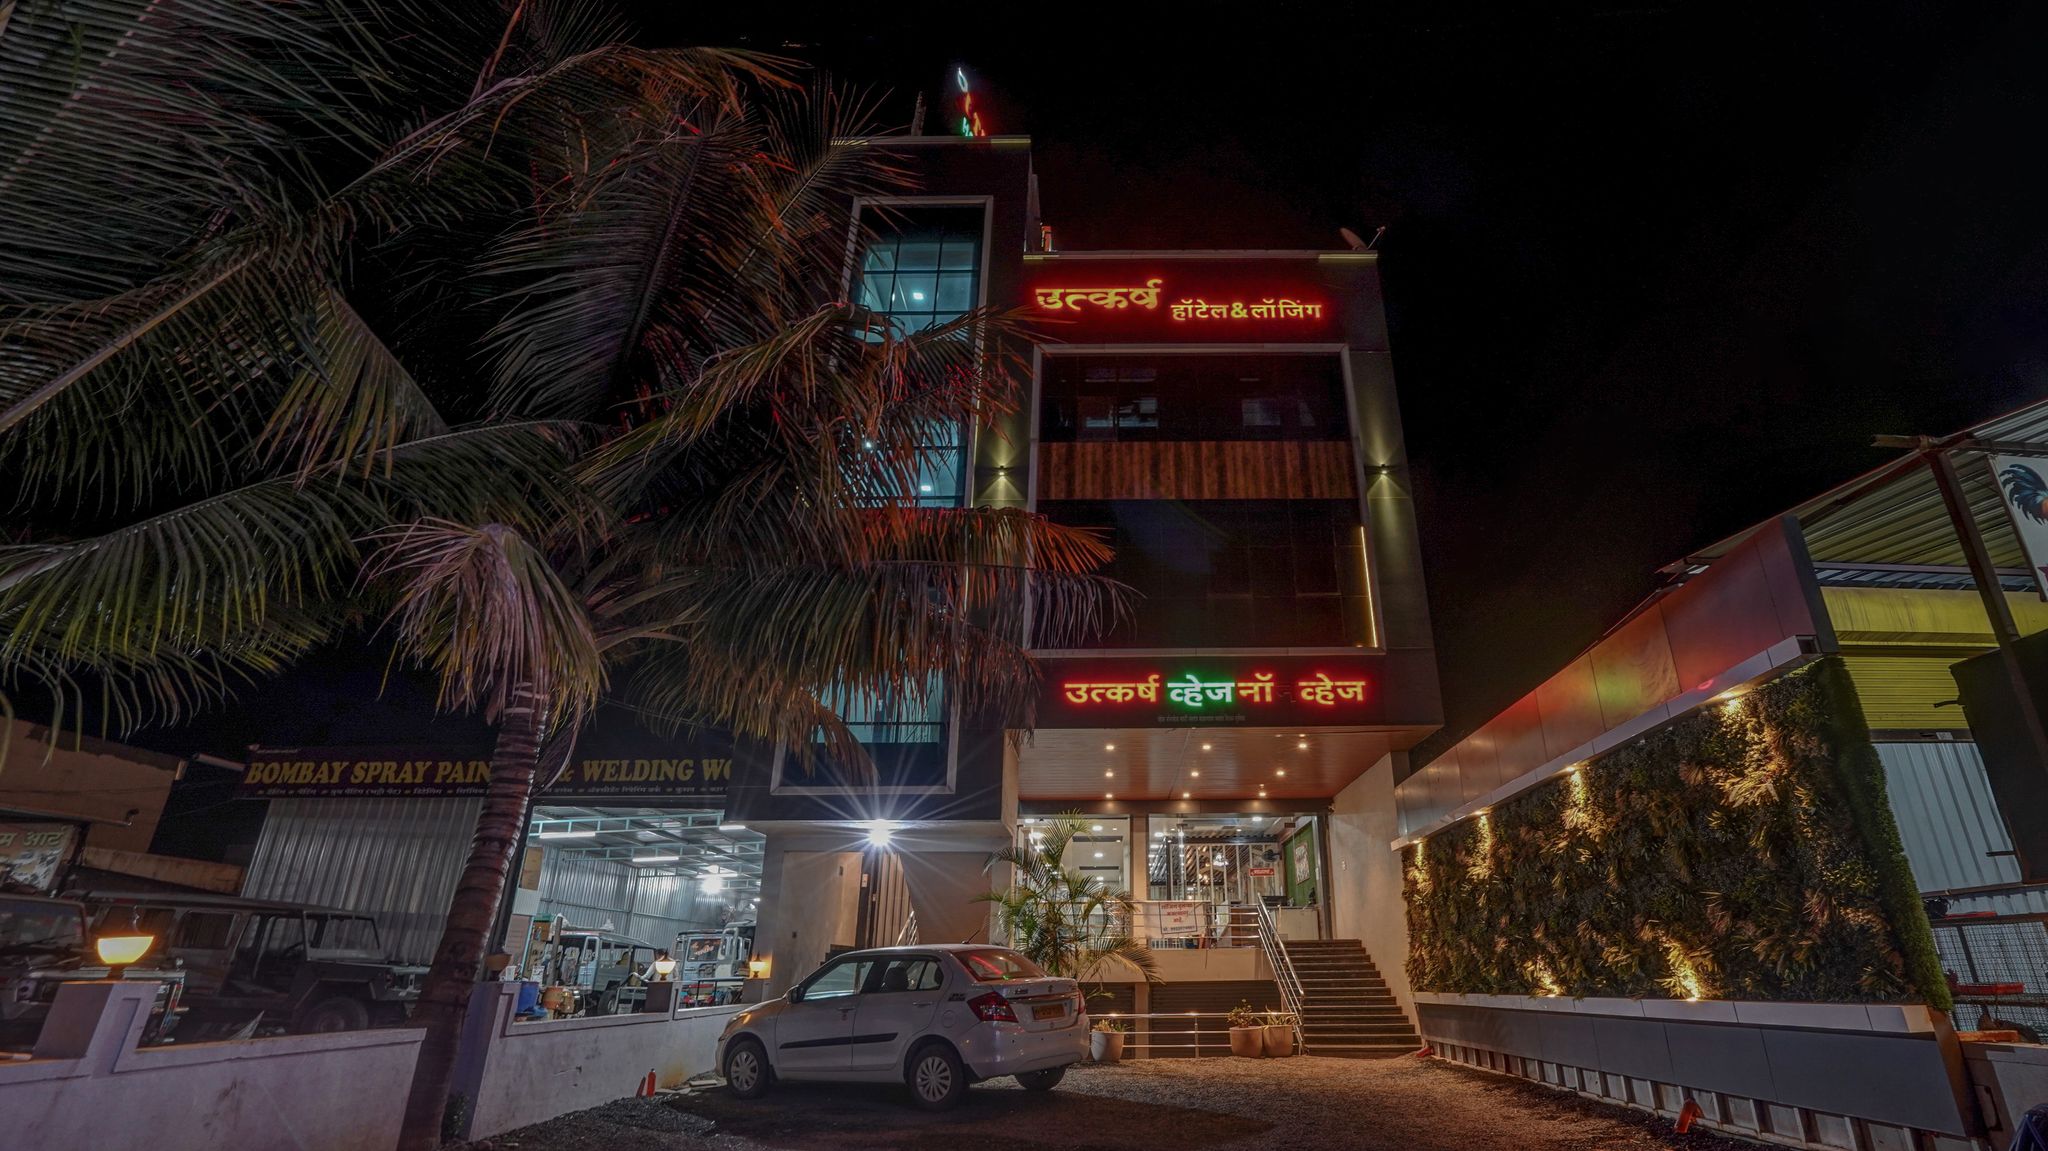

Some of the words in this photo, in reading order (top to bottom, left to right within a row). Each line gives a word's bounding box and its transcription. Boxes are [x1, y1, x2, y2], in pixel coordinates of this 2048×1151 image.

[1035, 279, 1162, 311] उत्कर्ष
[1064, 675, 1159, 703] उत्कर्ष
[1167, 674, 1235, 706] व्हेज
[1298, 673, 1366, 705] व्हेज
[245, 762, 348, 784] BOMBAY
[350, 762, 432, 784] SPRAY
[434, 761, 493, 784] PAIN
[582, 759, 695, 781] WELDING
